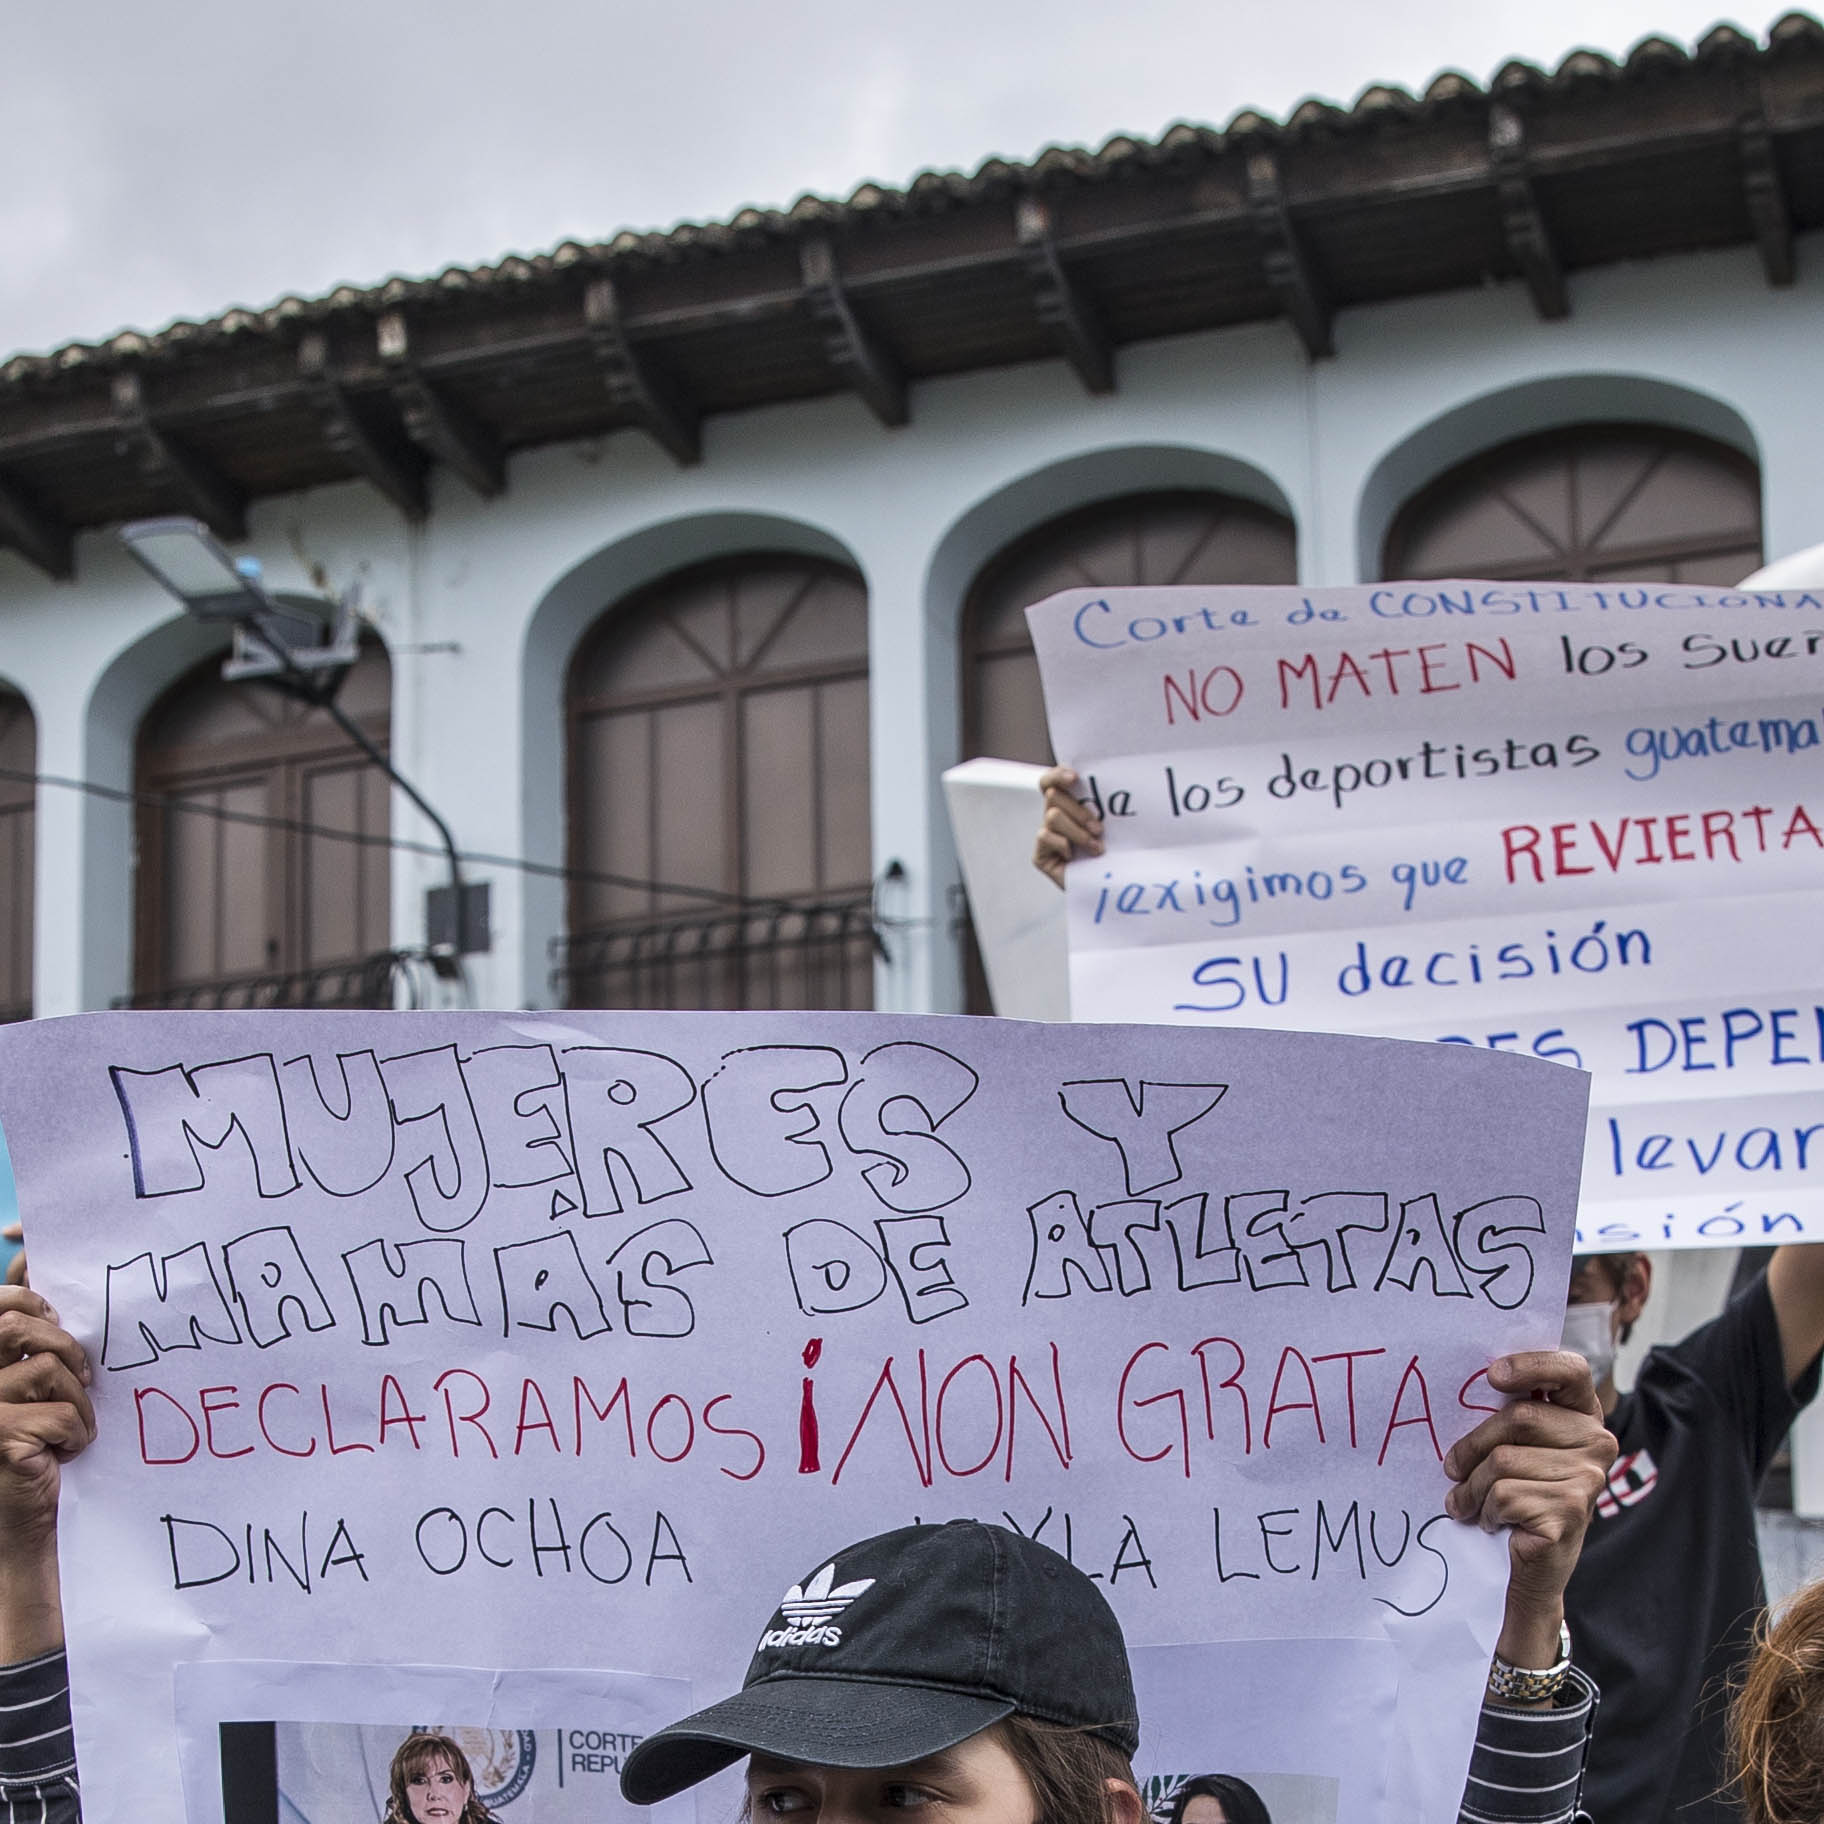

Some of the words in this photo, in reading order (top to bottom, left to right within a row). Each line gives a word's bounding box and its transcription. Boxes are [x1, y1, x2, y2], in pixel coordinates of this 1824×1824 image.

[1073, 599, 1259, 648] Corte
[1287, 597, 1347, 626] de
[1164, 665, 1243, 725] NO
[1277, 637, 1517, 709] MATEN
[1562, 634, 1648, 675] los
[1078, 776, 1137, 820] de
[1166, 767, 1244, 816] los
[1267, 731, 1600, 809] deportistas
[1392, 857, 1468, 911] que
[1175, 952, 1287, 1011] SU
[1338, 921, 1651, 998] decisión
[108, 1041, 979, 1232] MUJERES
[1058, 1078, 1229, 1196] Y
[784, 1215, 968, 1323] DE
[1023, 1189, 1546, 1309] ATLETAS
[1576, 1201, 1804, 1246] sión
[135, 1369, 765, 1482] DECLARAMOS
[160, 1510, 369, 1594] DINA
[414, 1497, 692, 1586] OCHOA
[1213, 1500, 1458, 1617] LEMUS
